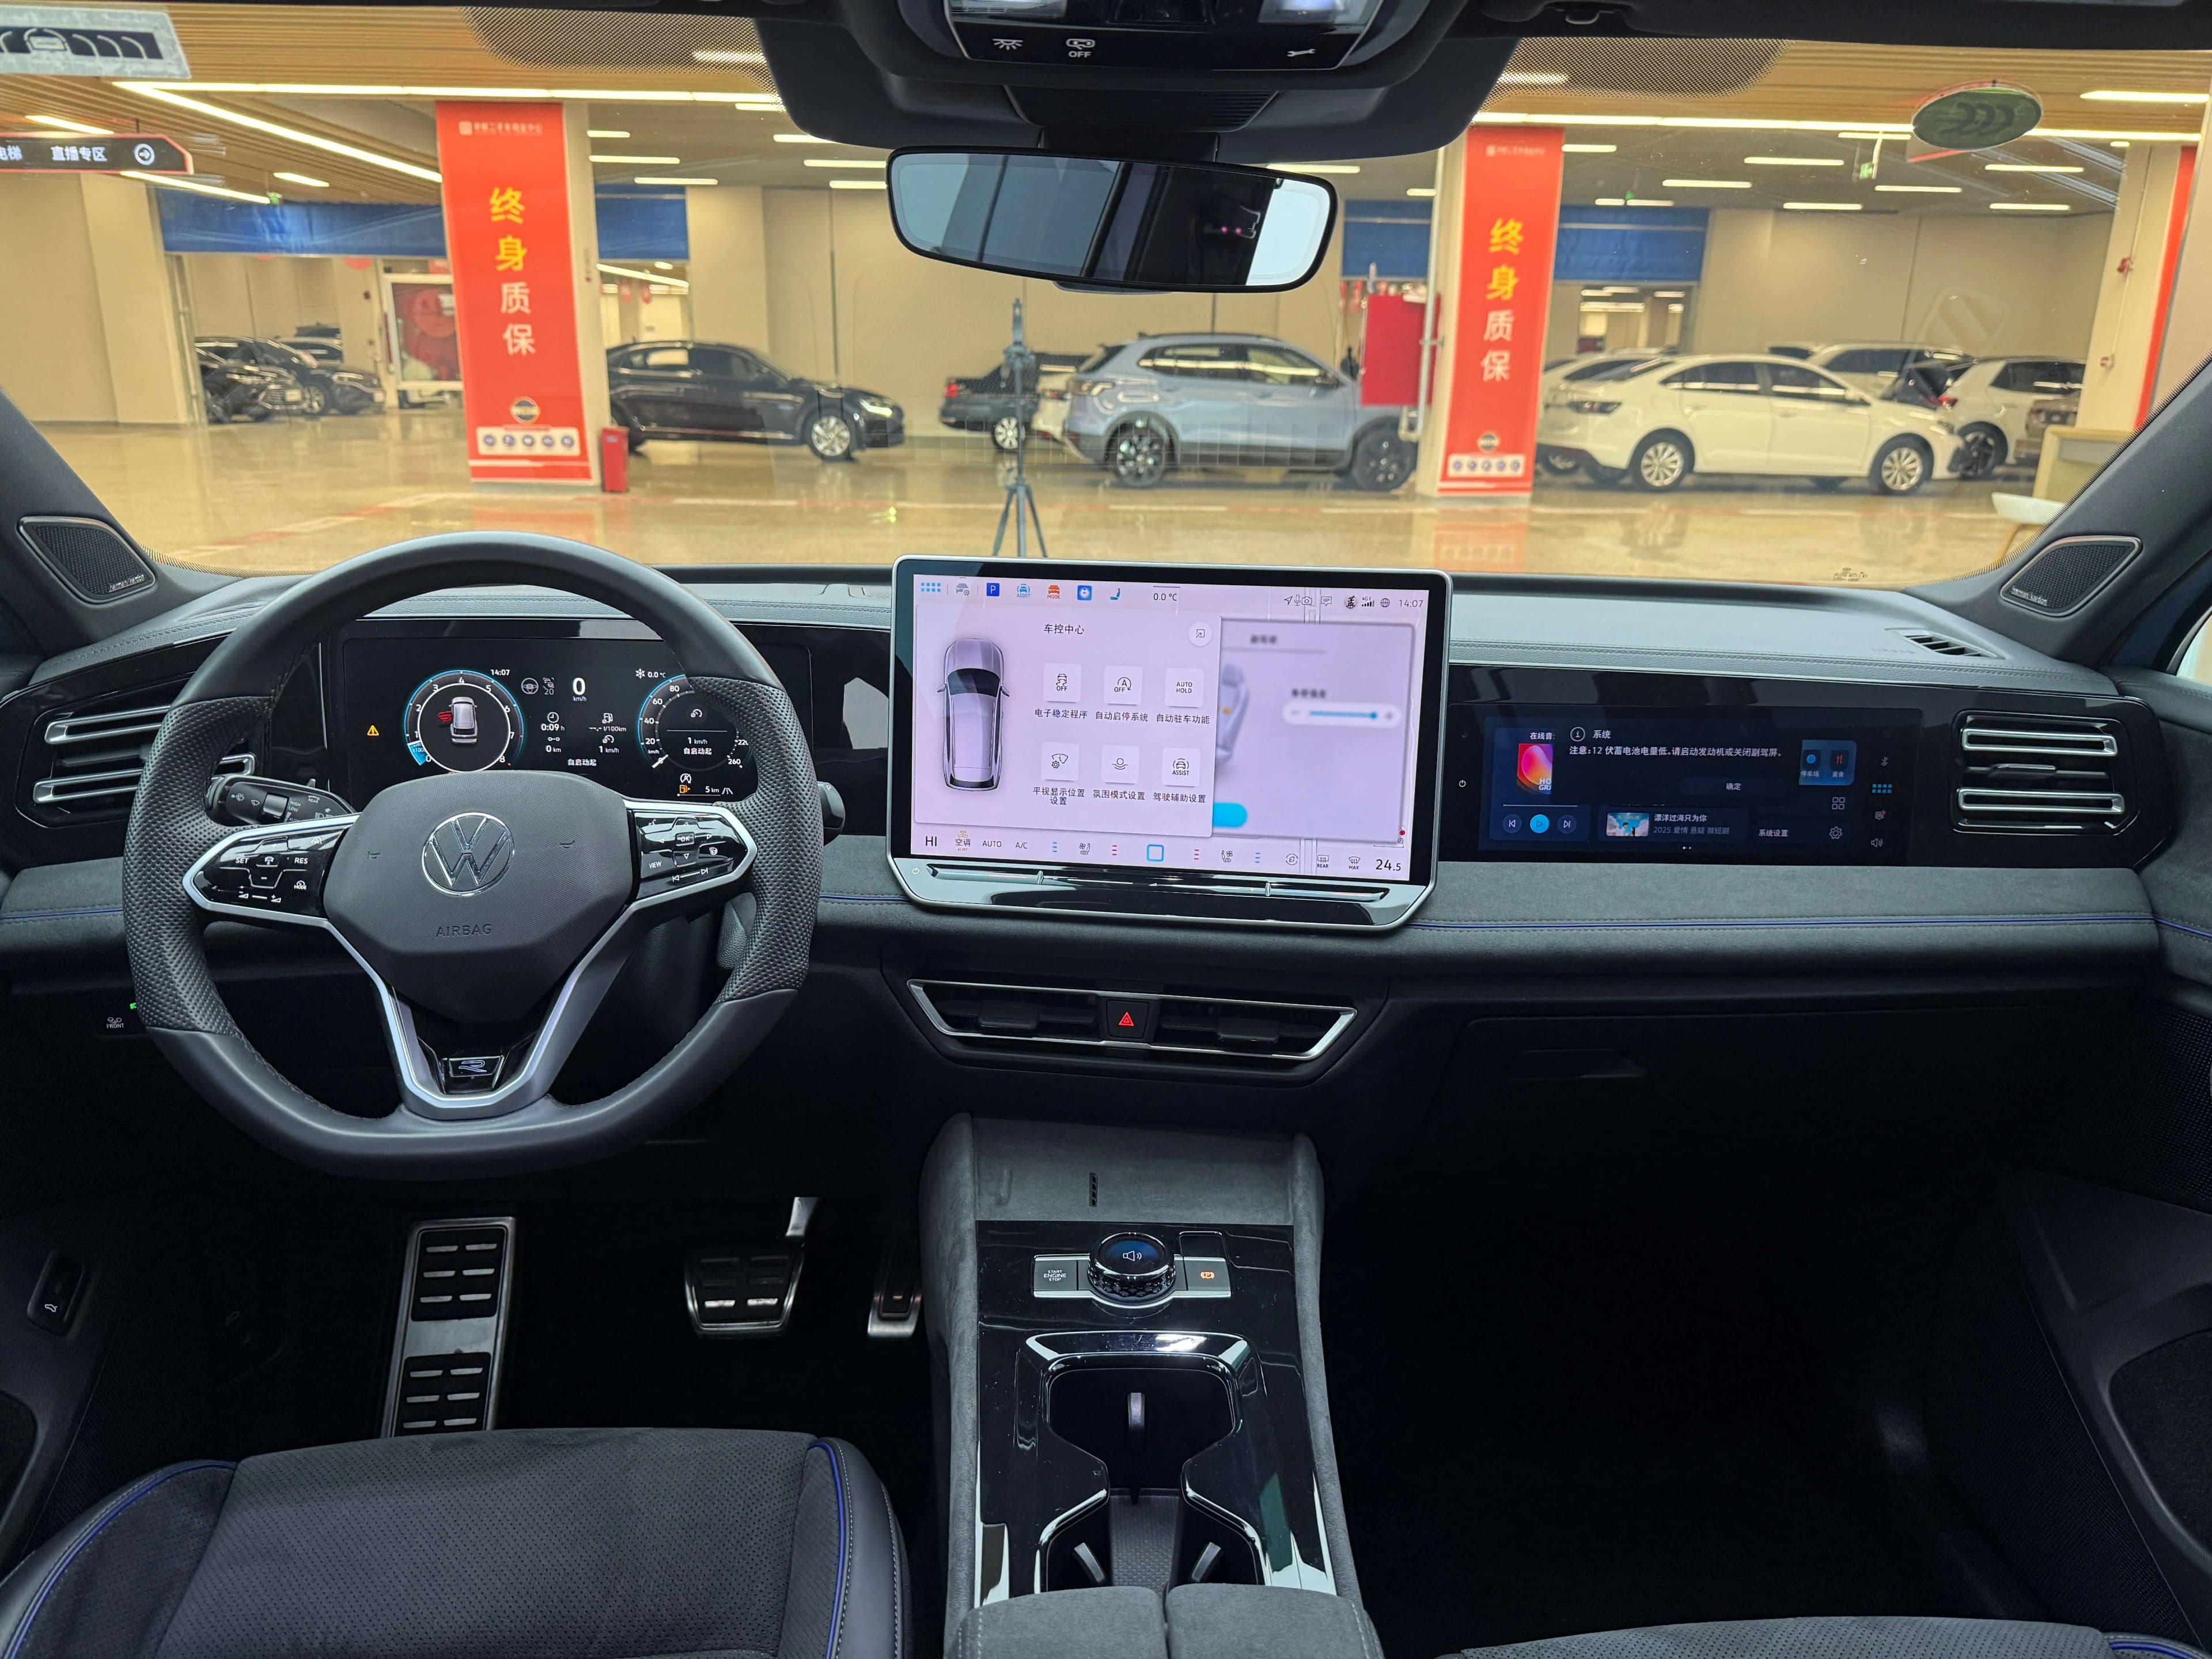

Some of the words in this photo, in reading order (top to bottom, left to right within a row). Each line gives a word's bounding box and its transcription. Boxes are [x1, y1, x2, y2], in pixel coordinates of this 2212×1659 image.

[1068, 50, 1092, 58] OFF
[50, 146, 108, 162] 直播专区
[488, 187, 536, 355] 终身质保
[1480, 218, 1524, 382] 终身质保
[1153, 592, 1166, 601] 0.0
[1399, 599, 1423, 608] 14:07
[1043, 624, 1085, 635] 车控中心
[573, 677, 586, 695] 0
[1035, 709, 1088, 719] 电子稳定程序
[1095, 711, 1148, 722] 自动启停系统
[1156, 713, 1210, 724] 自动驻车功能
[1592, 729, 1611, 739] 系统
[1032, 787, 1085, 797] 平视显示位置
[1093, 790, 1146, 800] 氛围模式设置
[1153, 792, 1206, 803] 驾驶辅助设置
[1050, 797, 1067, 805] 设置
[1654, 814, 1707, 822] 漂洋过海只为你
[1758, 829, 1789, 838] 系统设置
[925, 836, 937, 847] HI
[955, 839, 971, 847] 空调
[1375, 859, 1402, 871] 24.5
[435, 924, 492, 937] AIRBAG
